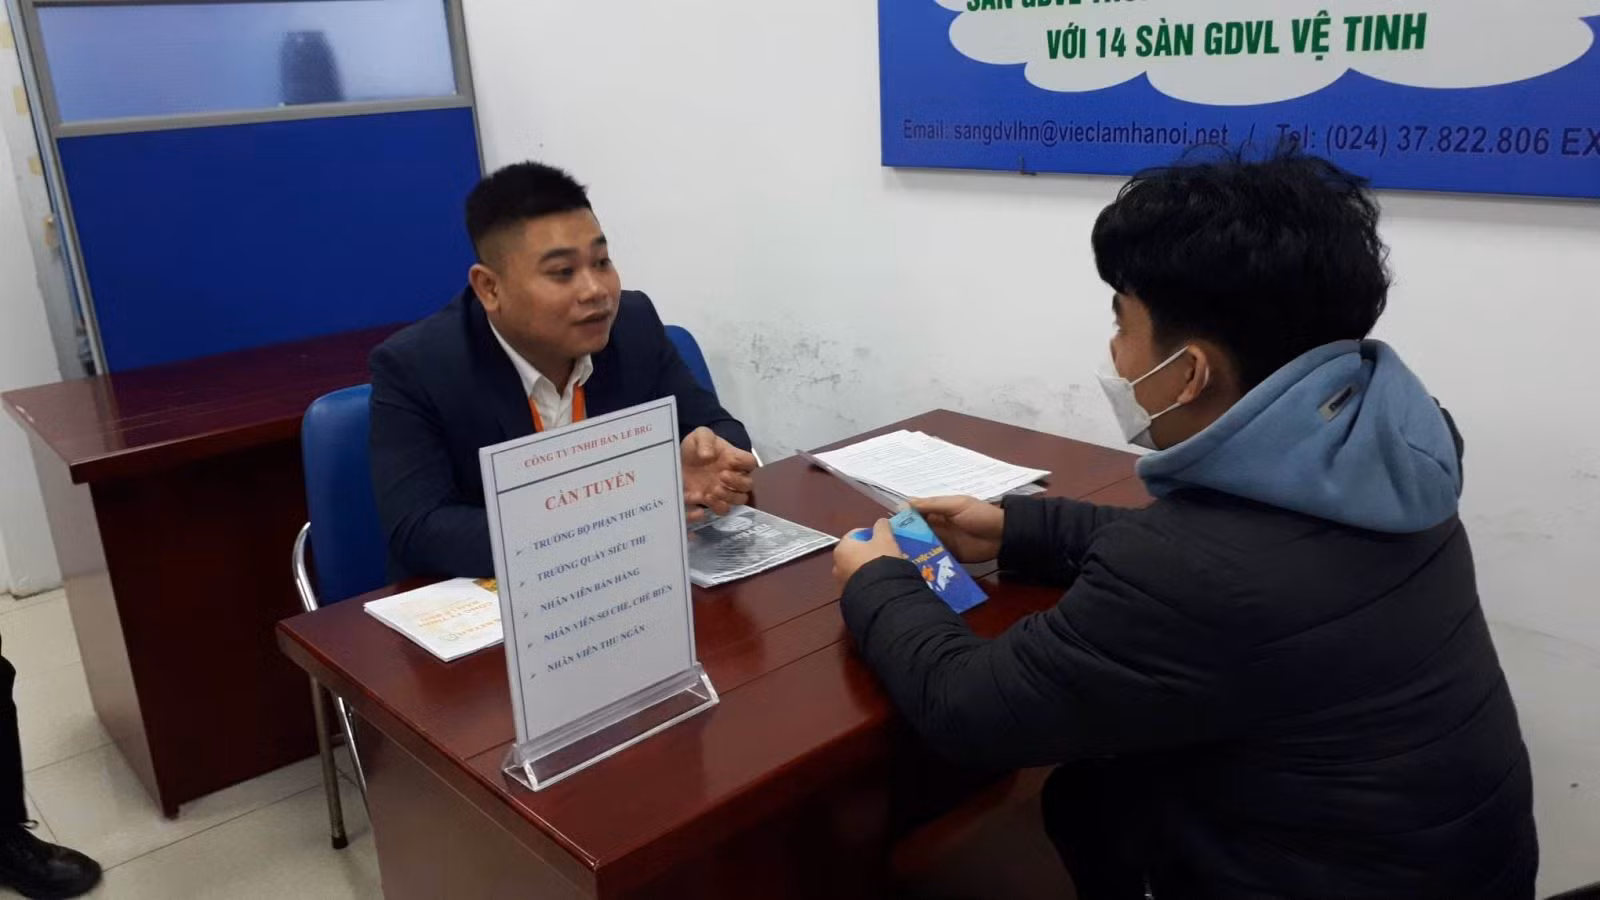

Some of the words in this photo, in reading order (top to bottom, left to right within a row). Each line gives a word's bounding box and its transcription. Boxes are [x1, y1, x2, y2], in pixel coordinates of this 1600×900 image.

[1047, 22, 1086, 59] VỚI
[1096, 27, 1126, 58] 14
[1136, 18, 1194, 57] SÀN
[1205, 20, 1279, 56] GDVL
[1291, 10, 1331, 61] VỆ
[1343, 12, 1427, 51] TINH
[903, 119, 949, 139] Email:
[954, 118, 1229, 147] sangdvlhn@vieclamhanoi.net
[1326, 124, 1387, 157] (024)
[1397, 126, 1549, 155] 37.822.806
